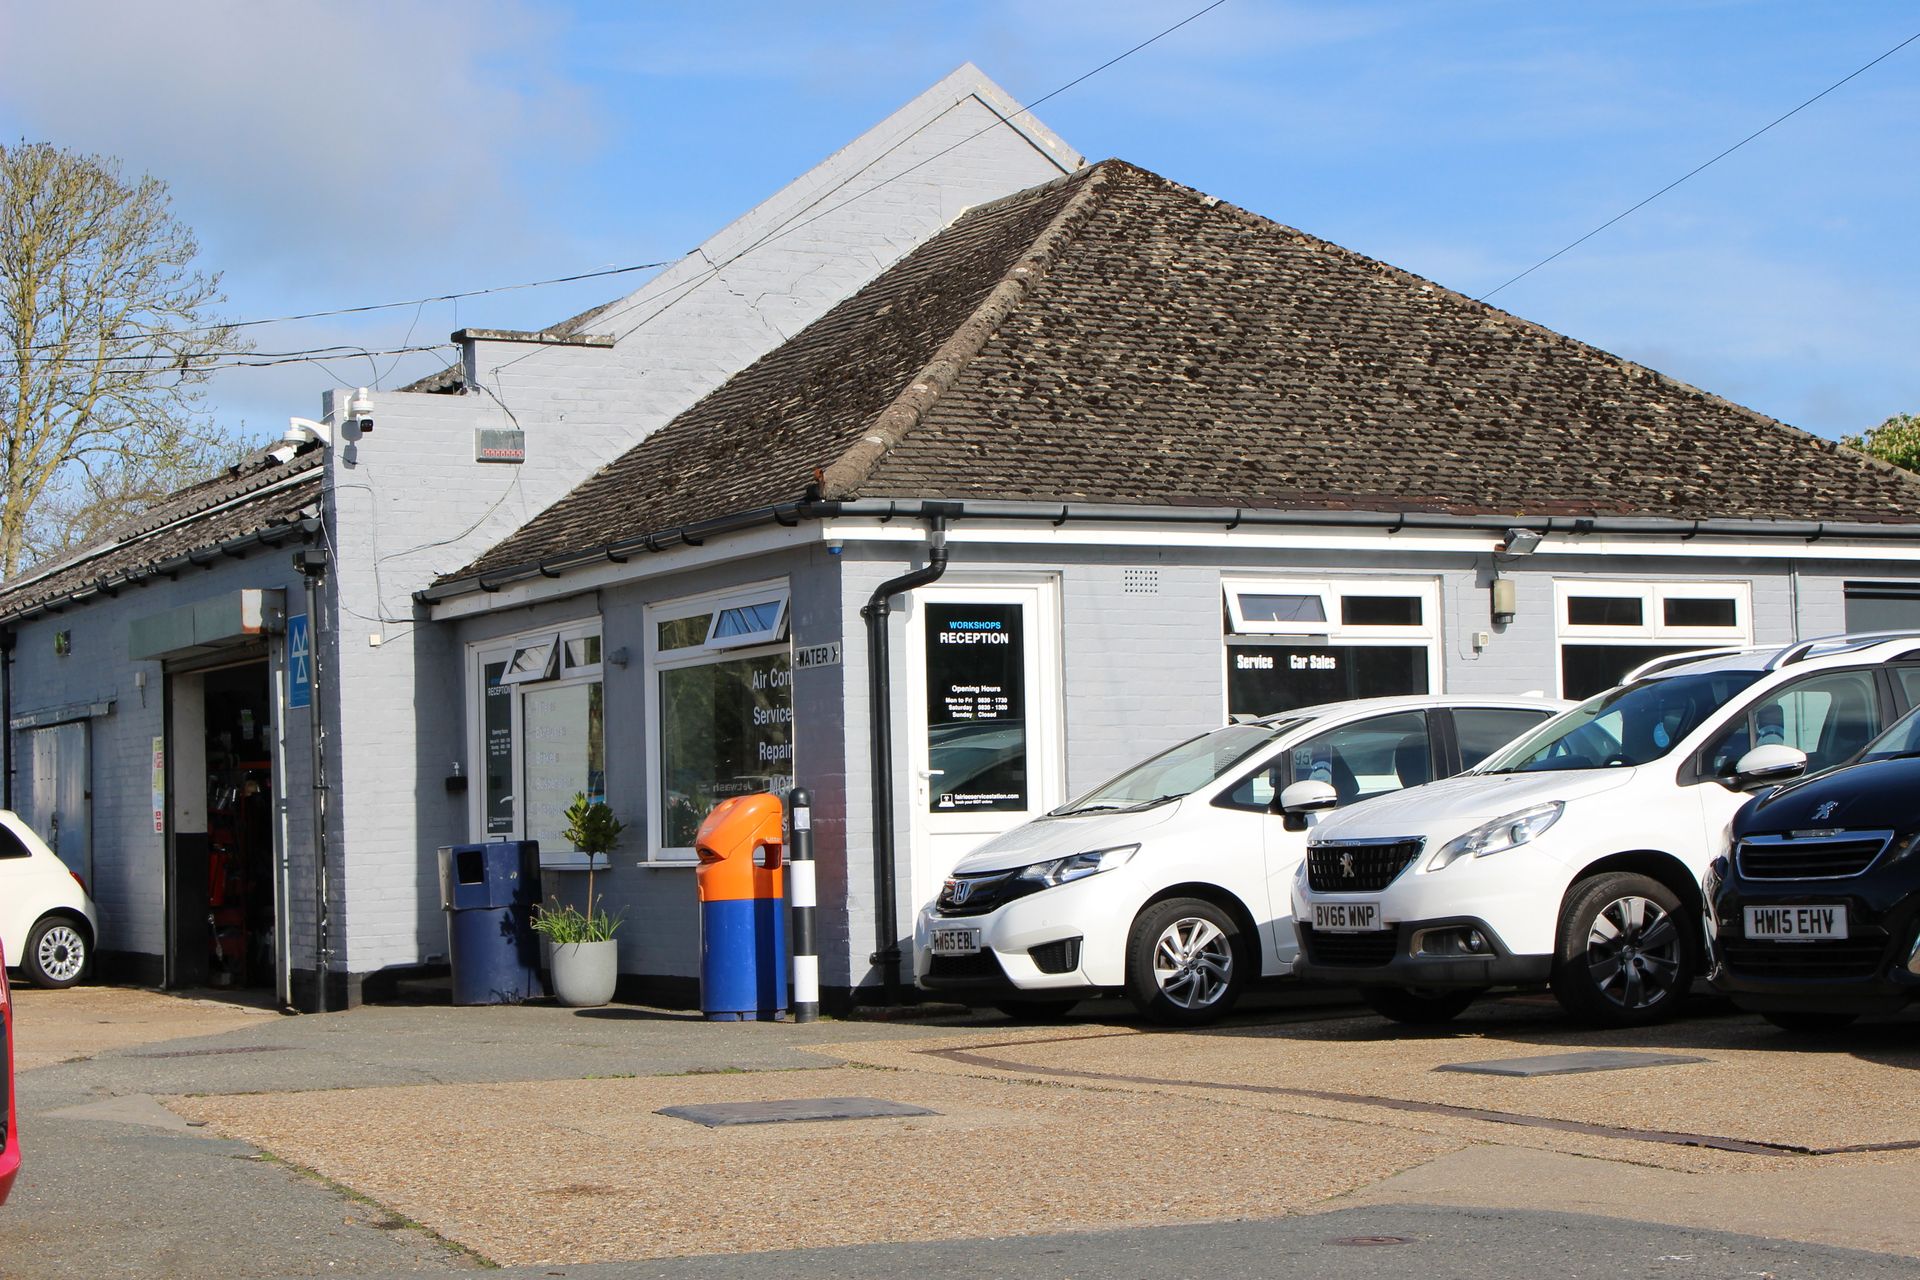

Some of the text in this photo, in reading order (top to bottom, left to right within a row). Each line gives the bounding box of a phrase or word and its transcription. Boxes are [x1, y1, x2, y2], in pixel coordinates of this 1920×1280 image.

[949, 621, 1001, 630] WORKSHOPS
[940, 632, 1009, 644] RECEPTION
[799, 649, 828, 667] WATER
[1237, 654, 1336, 669] Service Car Sales
[752, 670, 767, 690] Air
[951, 685, 980, 693] Opening
[753, 705, 792, 725] Service
[759, 739, 792, 764] Repair
[1316, 905, 1374, 926] BV66 WNP
[1797, 909, 1834, 934] EHV
[957, 931, 977, 950] EBL
